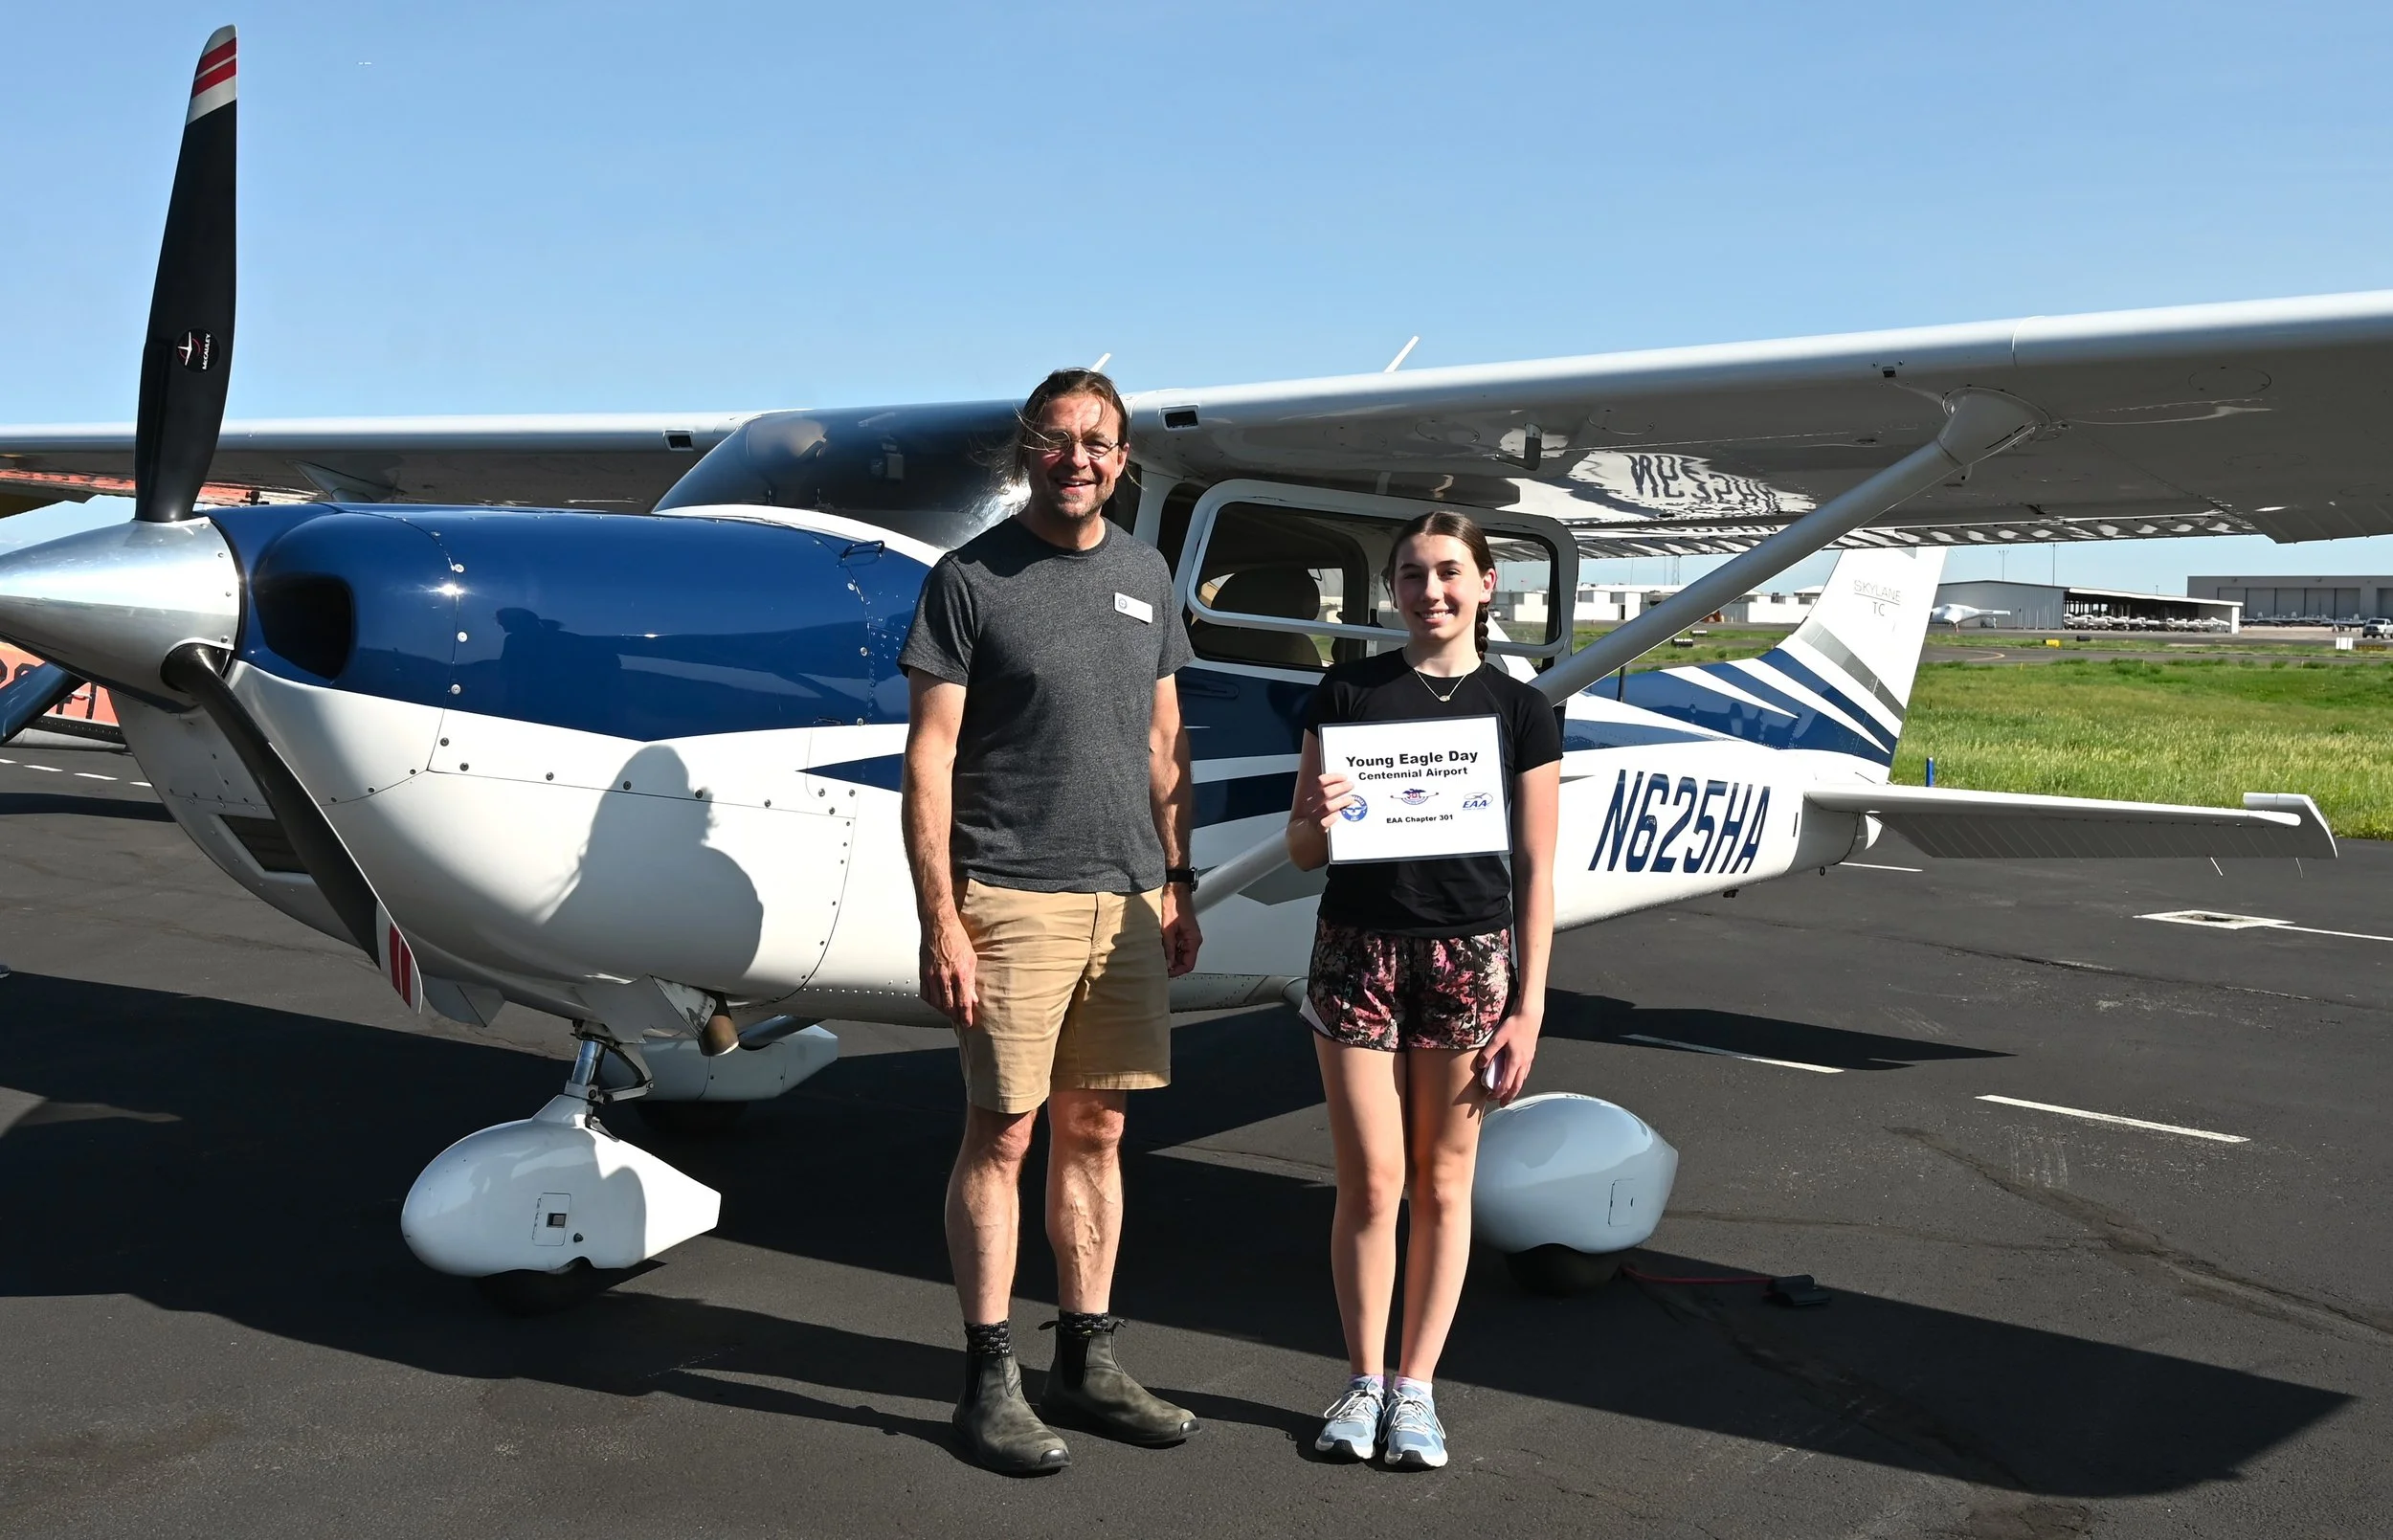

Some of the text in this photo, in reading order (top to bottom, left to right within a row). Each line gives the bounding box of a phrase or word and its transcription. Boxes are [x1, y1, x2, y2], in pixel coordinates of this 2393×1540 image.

[1853, 579, 1901, 603] SKYLANE
[1346, 750, 1478, 769] Young Eagle Day
[1358, 767, 1468, 781] Centennial Airport
[1462, 799, 1487, 809] EAA
[1404, 815, 1437, 824] Chapter
[1587, 769, 1771, 875] N625HA
